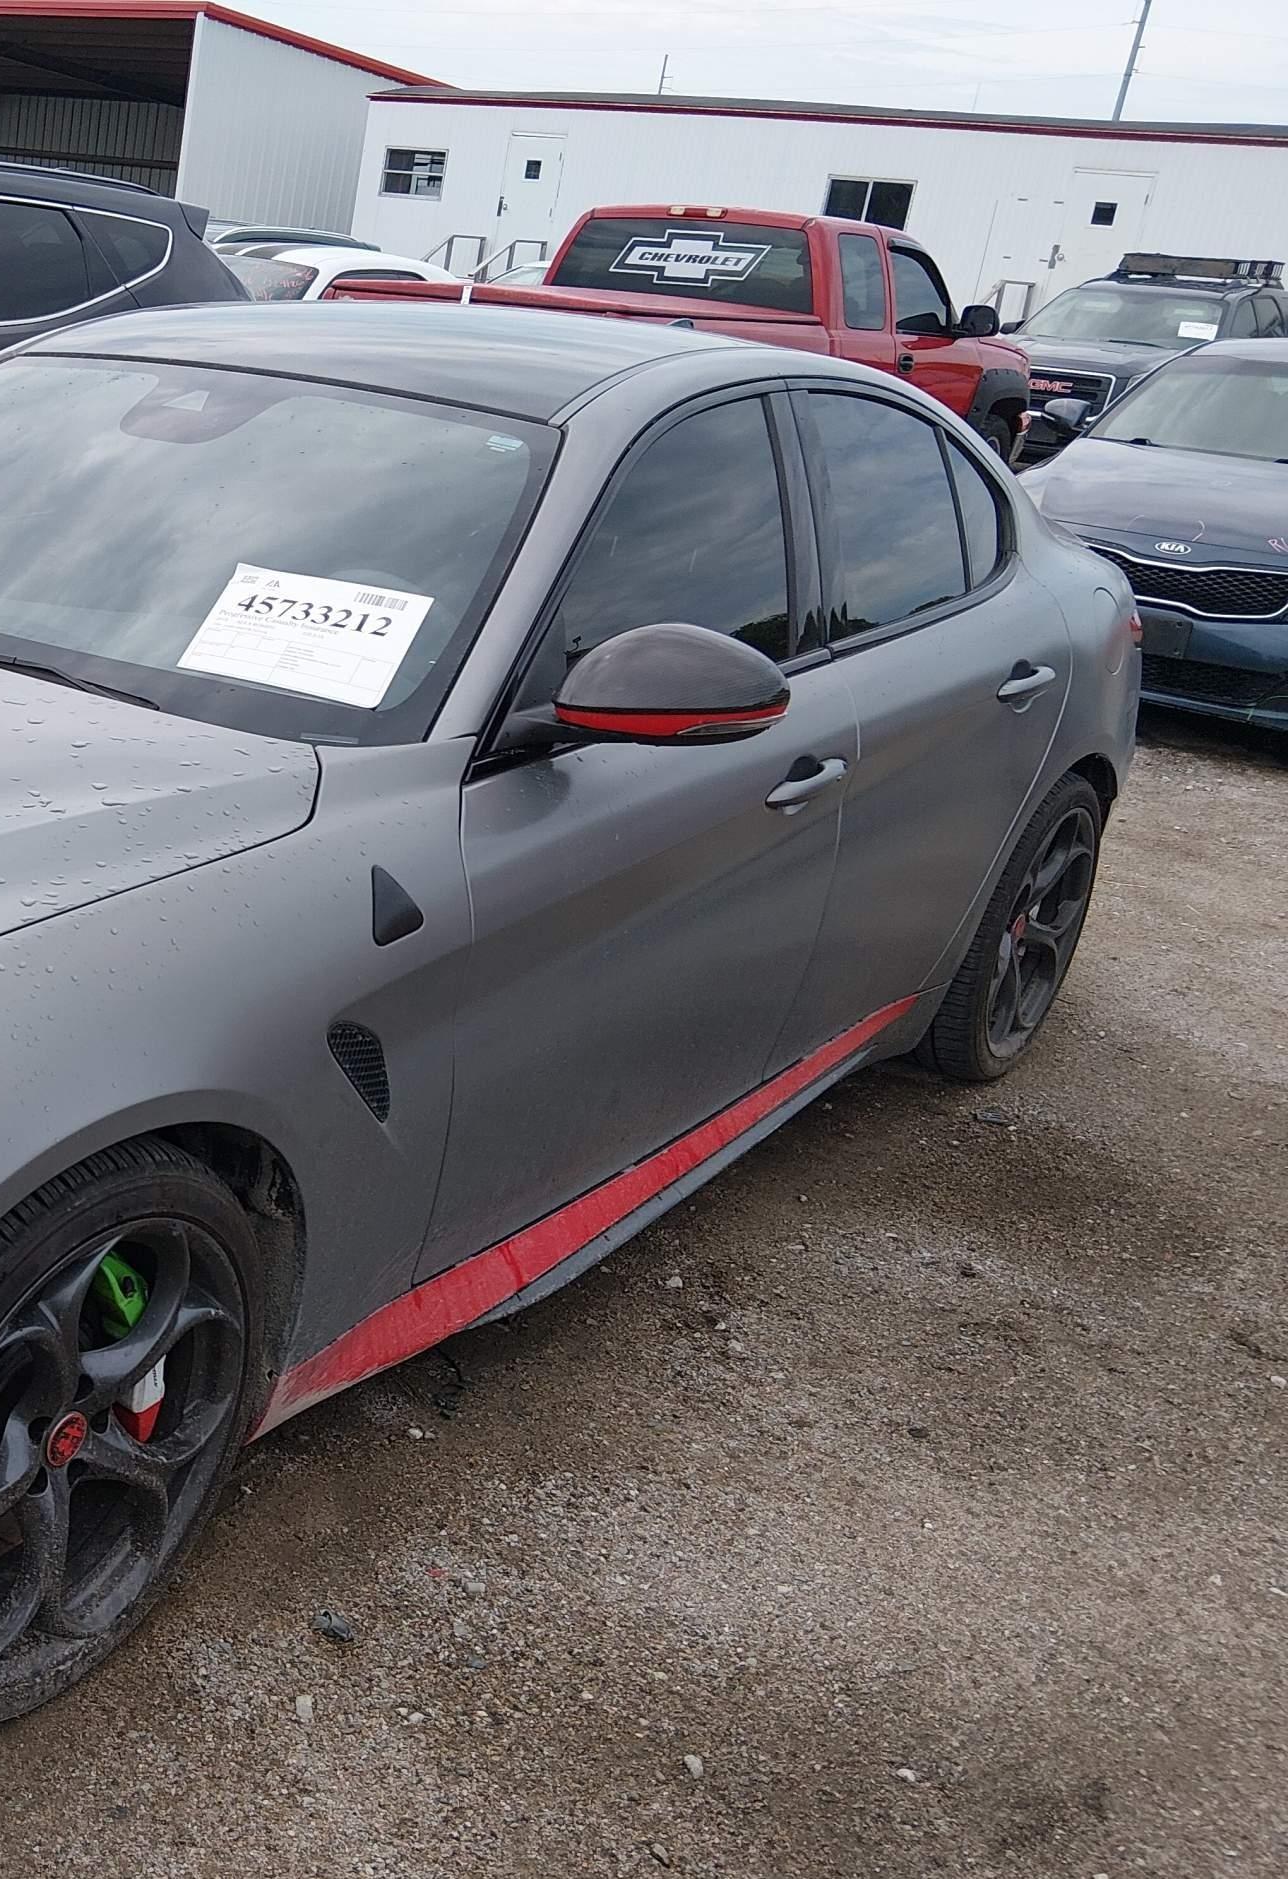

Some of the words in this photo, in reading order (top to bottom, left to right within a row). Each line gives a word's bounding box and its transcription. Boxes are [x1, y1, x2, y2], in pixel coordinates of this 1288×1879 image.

[638, 250, 748, 267] CHEVROLET
[1028, 378, 1073, 393] GMC
[1160, 541, 1185, 553] KIA
[238, 594, 393, 637] 45733212
